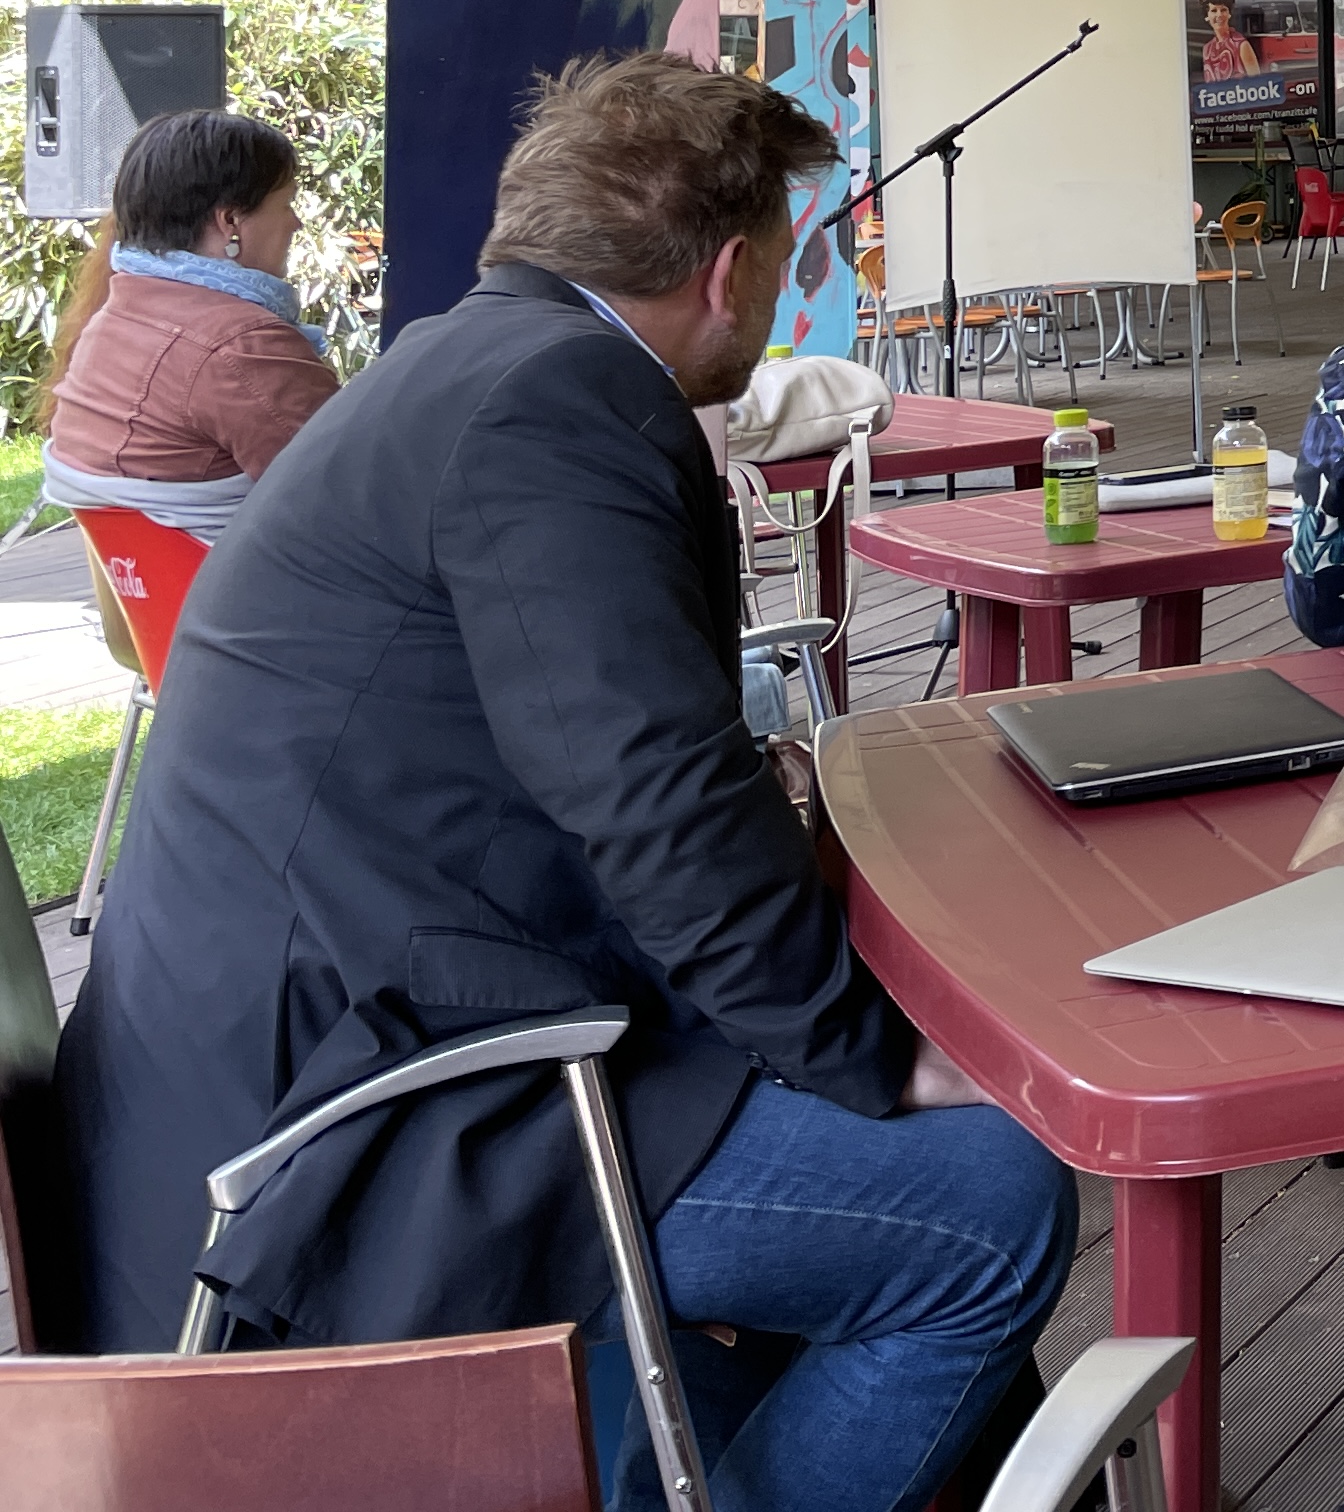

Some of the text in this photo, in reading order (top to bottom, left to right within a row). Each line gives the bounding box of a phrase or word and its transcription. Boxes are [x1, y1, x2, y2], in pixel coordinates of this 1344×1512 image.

[1198, 81, 1316, 108] facebook -on
[1194, 107, 1318, 124] www.facebook.com/tranzitcafe
